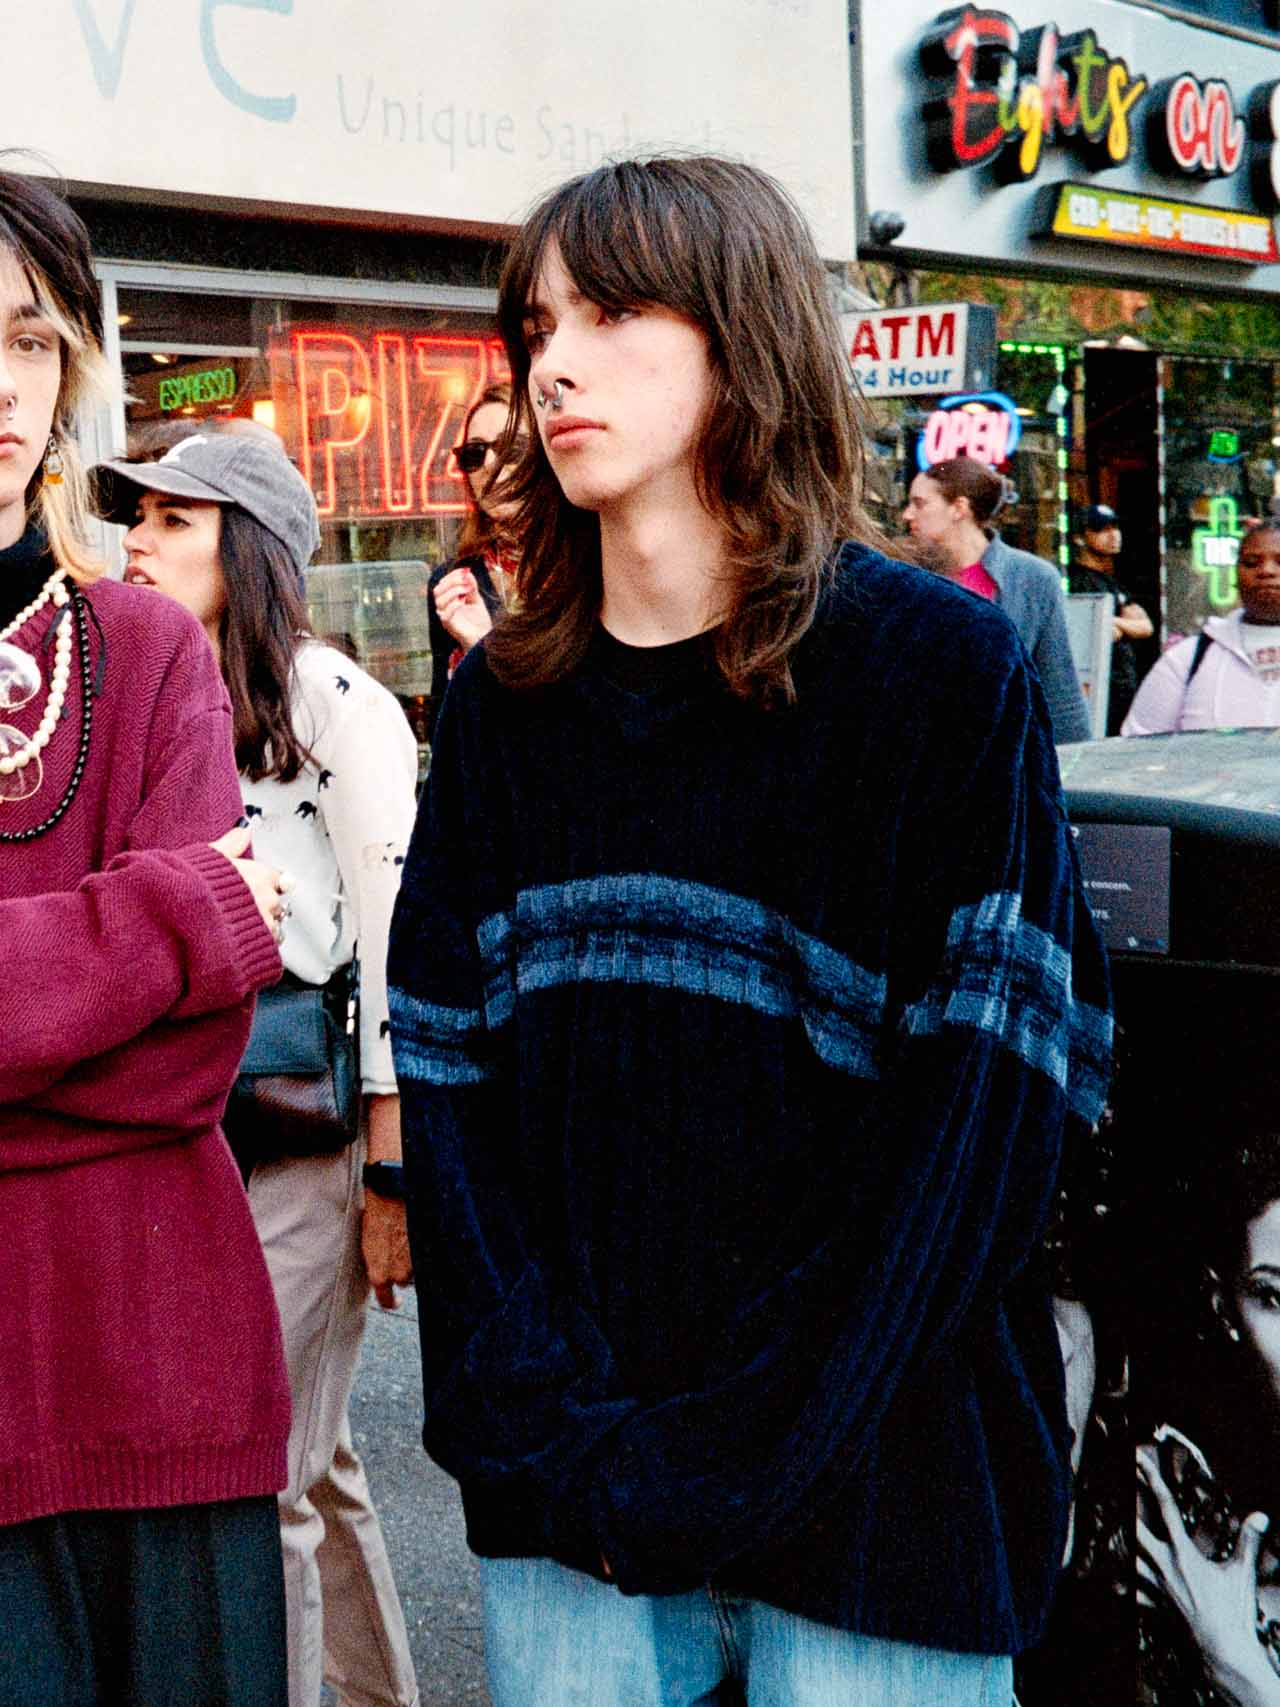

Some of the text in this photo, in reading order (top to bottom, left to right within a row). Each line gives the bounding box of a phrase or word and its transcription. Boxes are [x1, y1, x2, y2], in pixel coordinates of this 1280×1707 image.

[336, 73, 516, 171] Unique
[944, 12, 1147, 174] Eights
[1166, 77, 1245, 173] on
[850, 312, 956, 361] ATM
[887, 366, 953, 387] Hour
[293, 332, 513, 515] PIZ
[925, 410, 1013, 465] OPEN
